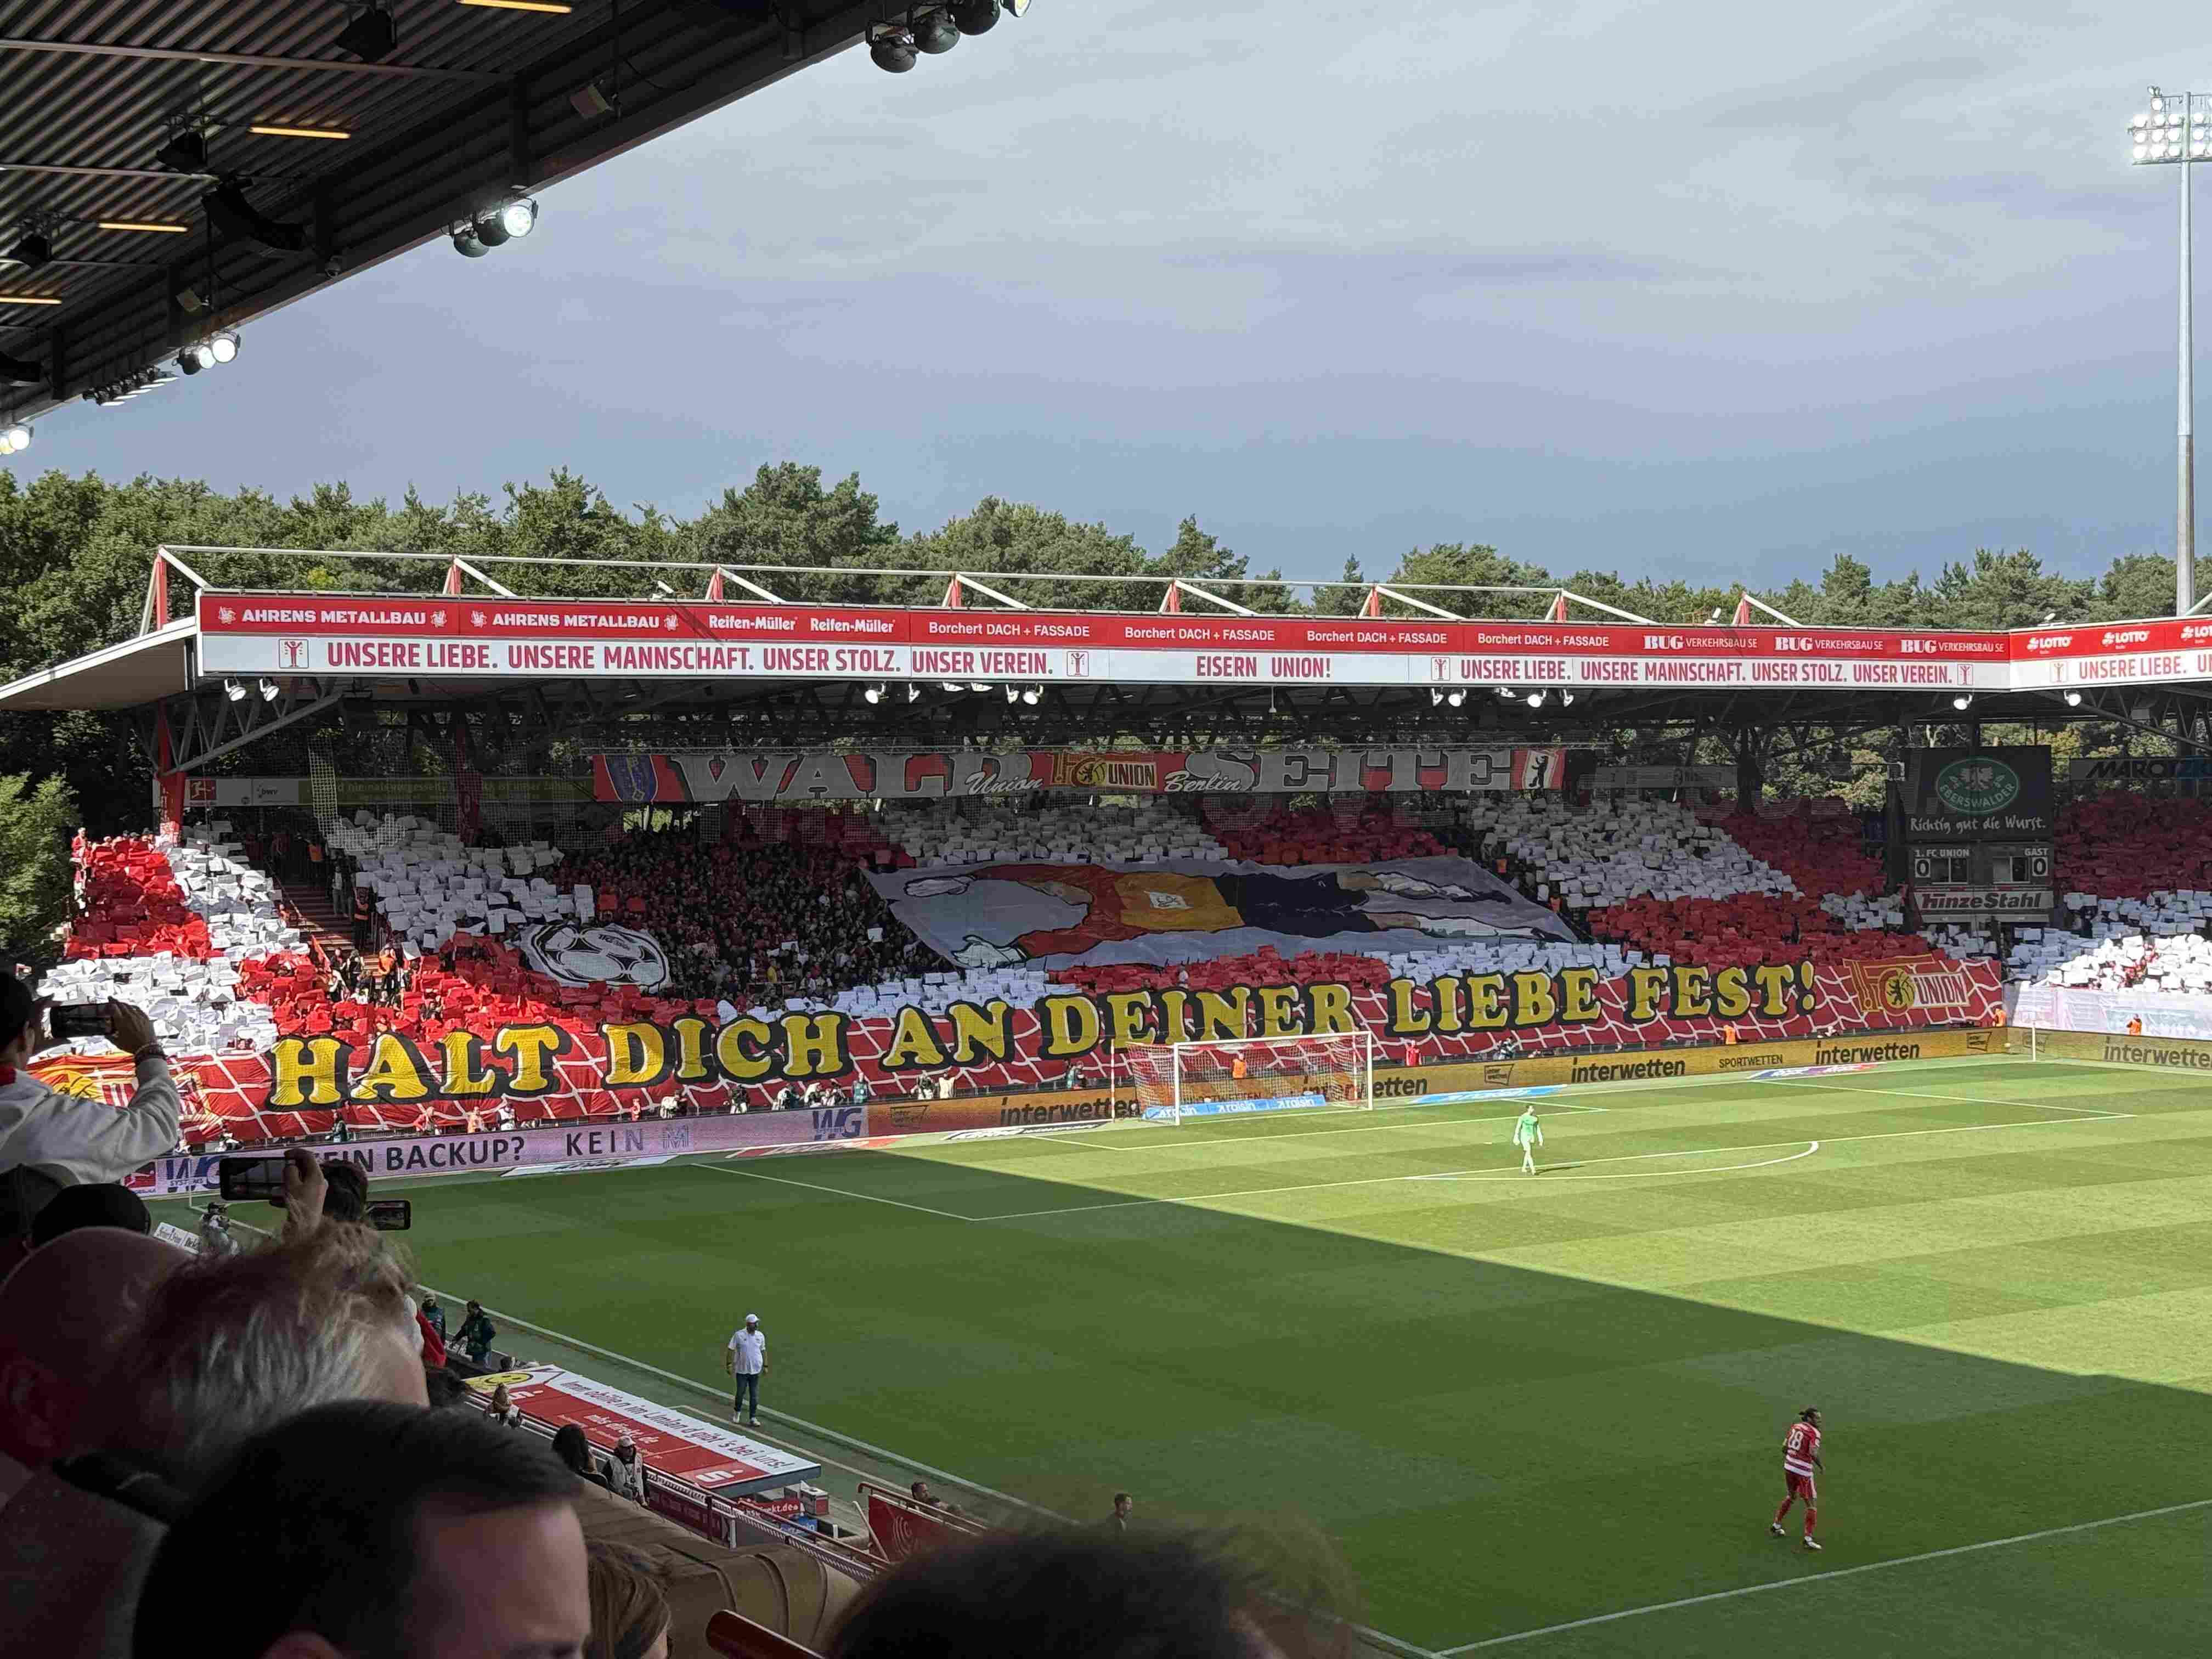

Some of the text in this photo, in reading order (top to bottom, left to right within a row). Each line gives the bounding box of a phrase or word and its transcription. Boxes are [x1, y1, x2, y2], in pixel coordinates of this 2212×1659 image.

[242, 609, 426, 625] AHRENS METALLBAU
[492, 613, 659, 628] AHRENS METALLBAU
[709, 615, 796, 631] Reifen-Müller
[810, 618, 894, 633] Reifen-Müller
[929, 622, 983, 634] Borchert
[987, 624, 1020, 636] DACH
[1034, 625, 1090, 637] FASSADE
[1125, 627, 1175, 639] Borchert
[1179, 629, 1210, 640] DACH
[1223, 630, 1274, 641] FASSADE
[1307, 630, 1354, 642] Borchert
[1357, 632, 1387, 642] DACH
[1398, 633, 1447, 644] FASSADE
[2115, 631, 2148, 642] LOTTO
[1478, 633, 1521, 645] Borchert
[1525, 635, 1553, 645] DACH
[1563, 636, 1609, 646] FASSADE
[1644, 635, 1757, 650] BUG VERKEHRSBAU SE
[1775, 637, 1883, 651] BUG VERKEHRSBAU SE
[1900, 640, 2004, 653] BUG VERKEHRSBAU SE
[2040, 637, 2070, 647] LOTTO
[328, 642, 1053, 674] UNSERE LIEBE. UNSERE MANNSCHAFT. UNSER STOLZ. UNSER VEREIN.
[1197, 656, 1331, 678] EISERN UNION!
[2080, 659, 2135, 679] UNSERE
[2140, 656, 2186, 676] LIEBE.
[1461, 659, 1952, 684] UNSERE LIEBE. UNSERE MANNSCHAFT. UNSER STOLZ. UNSER VEREIN.
[1108, 763, 1155, 787] UNION
[1185, 749, 1511, 792] SEITE
[964, 771, 1043, 795] Union
[1164, 771, 1243, 792] Berlin
[1940, 783, 2015, 808] EBERSWALDER
[1911, 815, 2046, 834] Richtig gut die Wurst.
[2024, 848, 2049, 856] GAST
[1916, 859, 1929, 876] 0
[2033, 857, 2047, 875] 0
[1914, 974, 1966, 1005] UNION
[270, 1026, 560, 1107] HALT
[601, 1015, 843, 1085] DICH
[882, 1002, 1008, 1066] AN
[1045, 984, 1356, 1054] DEINER
[1390, 968, 1601, 1032] LIEBE
[1632, 961, 1814, 1019] FEST!
[1719, 1054, 1782, 1069] SPORTWETTEN
[1815, 1041, 1920, 1064] interwetten
[2103, 1036, 2212, 1068] interwette
[1571, 1057, 1685, 1083] interwetten
[1000, 1097, 1140, 1124] interwetten
[566, 1128, 643, 1156] KEIN
[387, 1137, 524, 1170] BACKUP?
